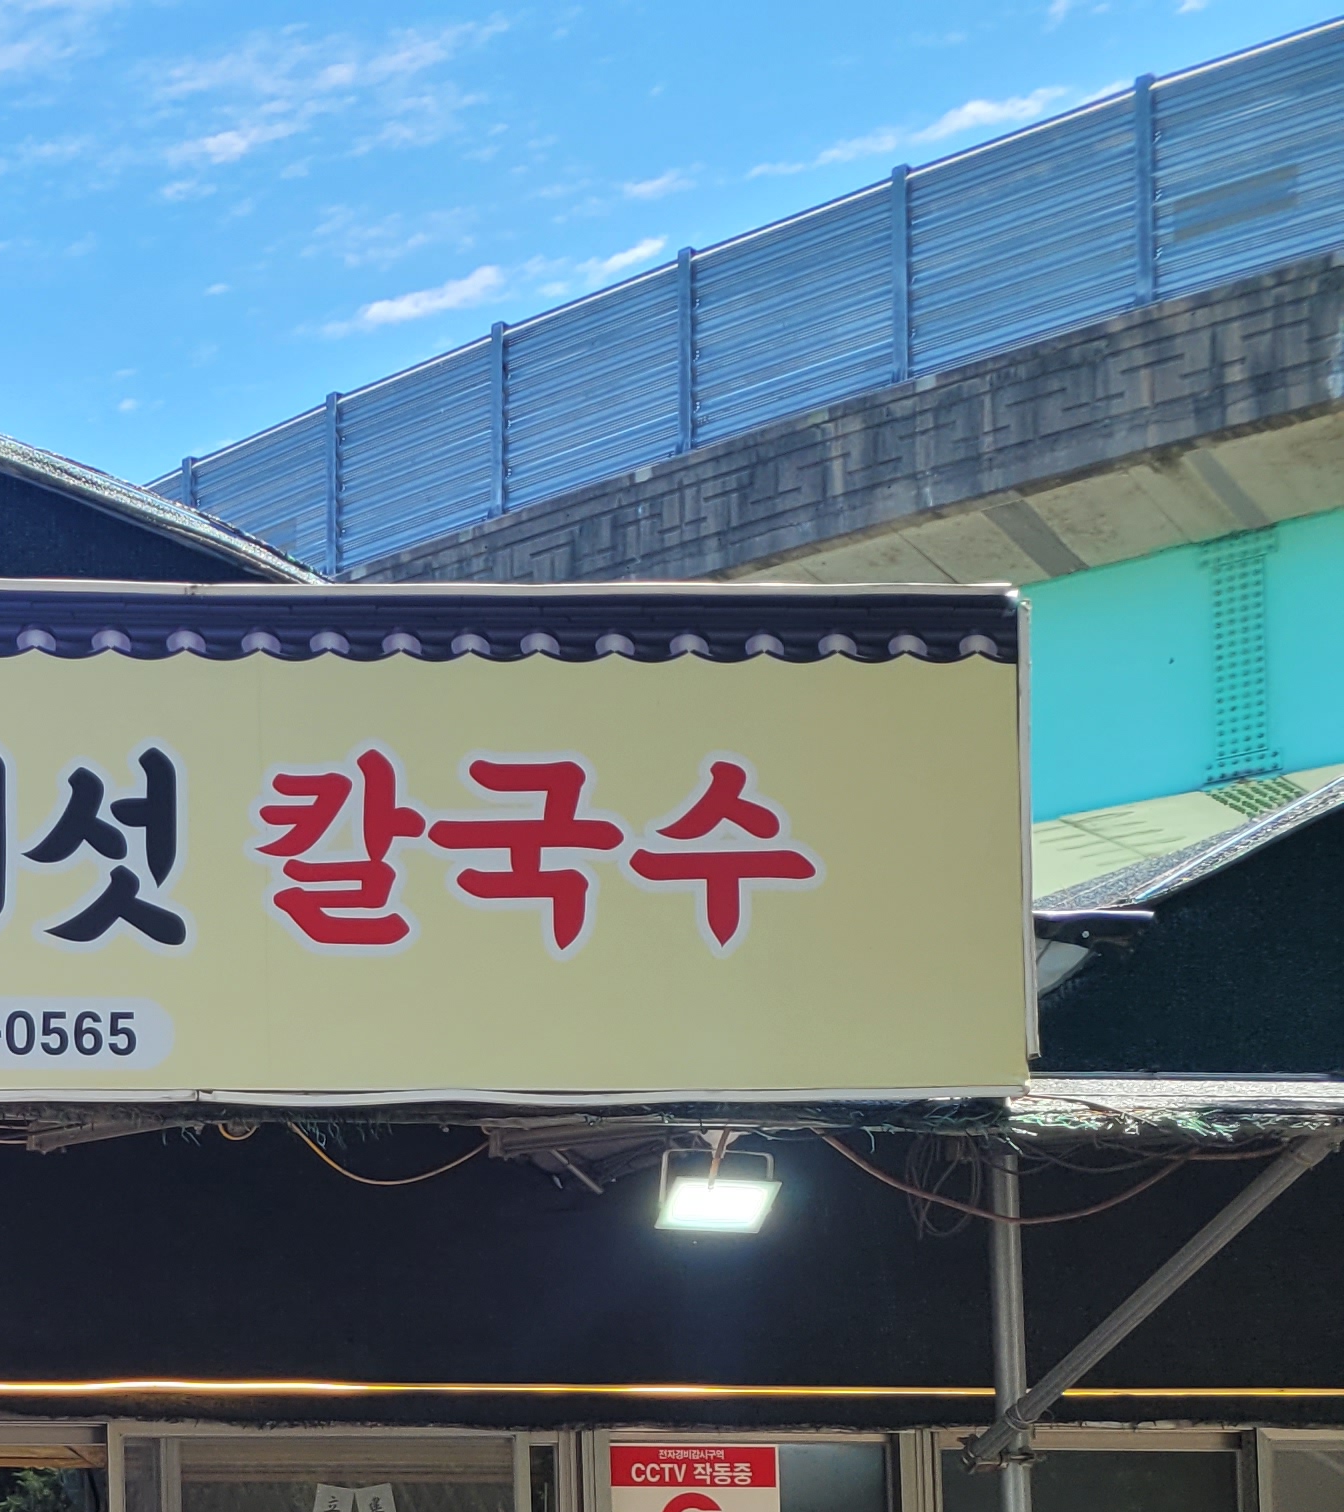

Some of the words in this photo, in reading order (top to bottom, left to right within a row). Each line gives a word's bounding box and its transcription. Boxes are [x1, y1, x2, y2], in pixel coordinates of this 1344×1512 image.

[257, 748, 818, 951] 칼국수
[658, 1449, 725, 1460] 전자경비감시구역
[631, 1463, 687, 1482] CCTV
[693, 1462, 753, 1485] 작동중
